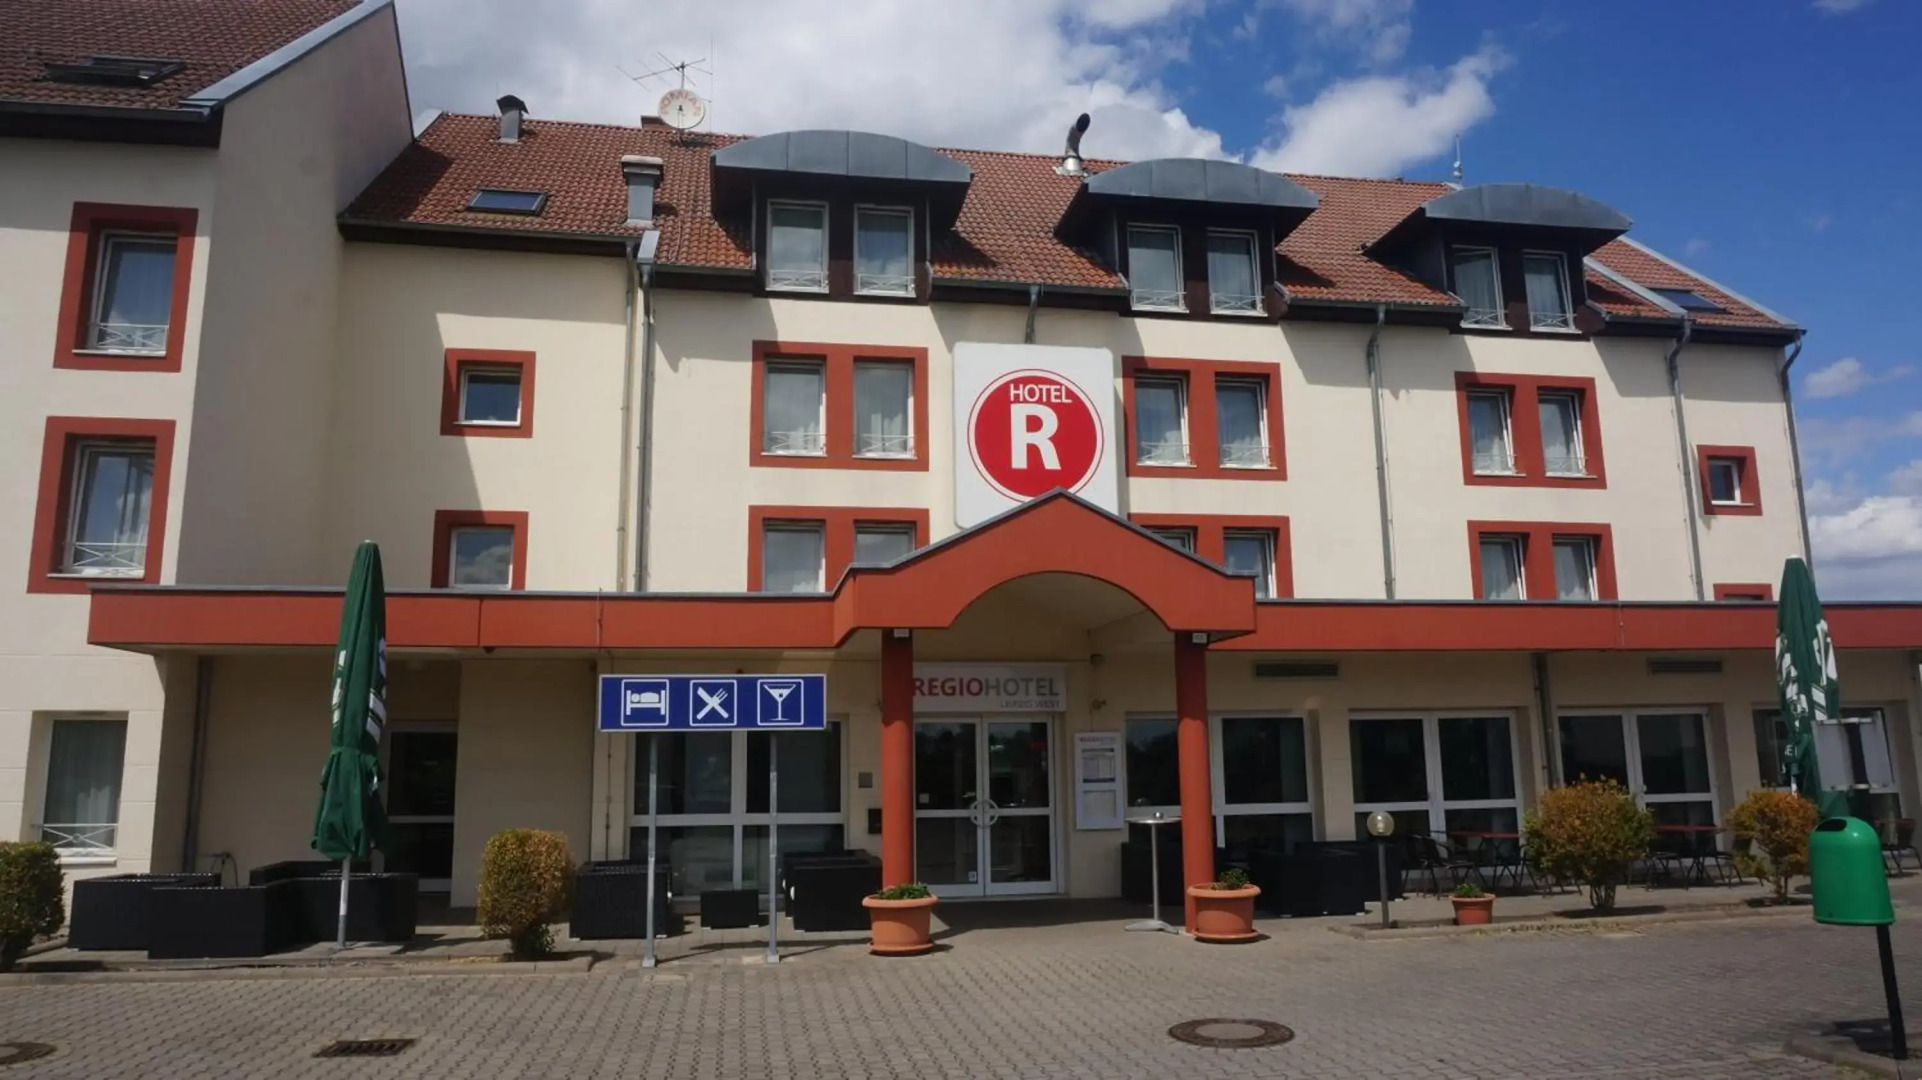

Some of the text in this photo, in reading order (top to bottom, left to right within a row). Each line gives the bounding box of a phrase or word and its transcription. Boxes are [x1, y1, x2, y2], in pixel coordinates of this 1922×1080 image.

[1009, 383, 1072, 403] HOTEL
[1010, 403, 1062, 470] R
[912, 677, 1060, 697] REGIOHOTEL
